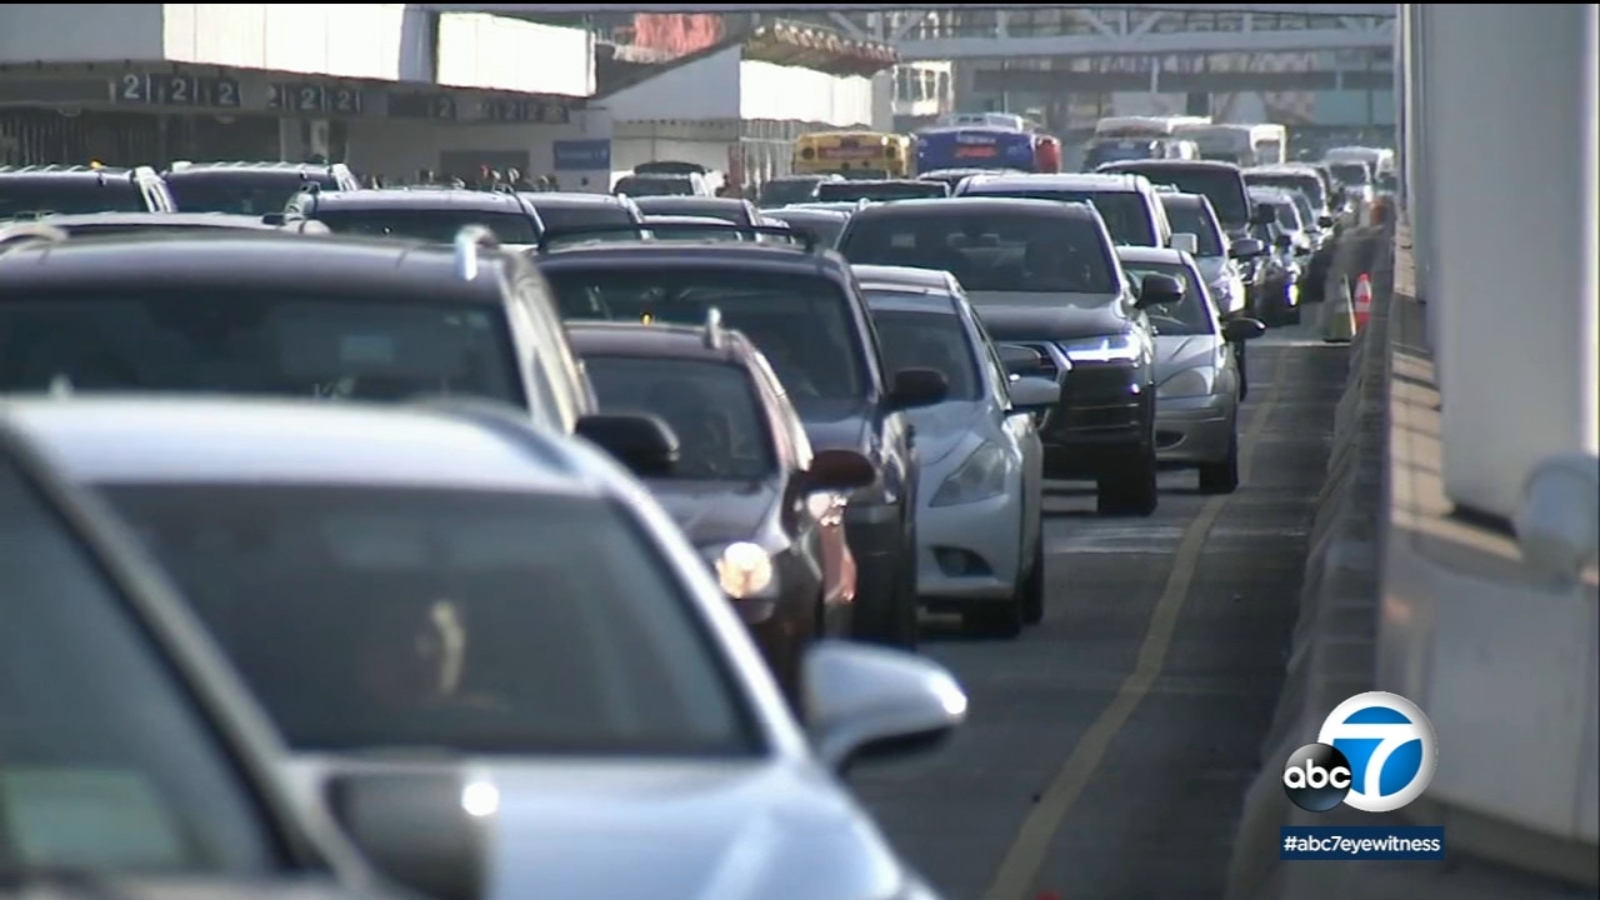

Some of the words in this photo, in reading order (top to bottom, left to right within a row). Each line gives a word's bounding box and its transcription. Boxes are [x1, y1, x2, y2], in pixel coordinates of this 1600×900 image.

[123, 73, 140, 99] 2
[171, 78, 187, 101] 2
[219, 82, 234, 105] 2
[301, 88, 316, 109] 2
[338, 90, 351, 110] 2
